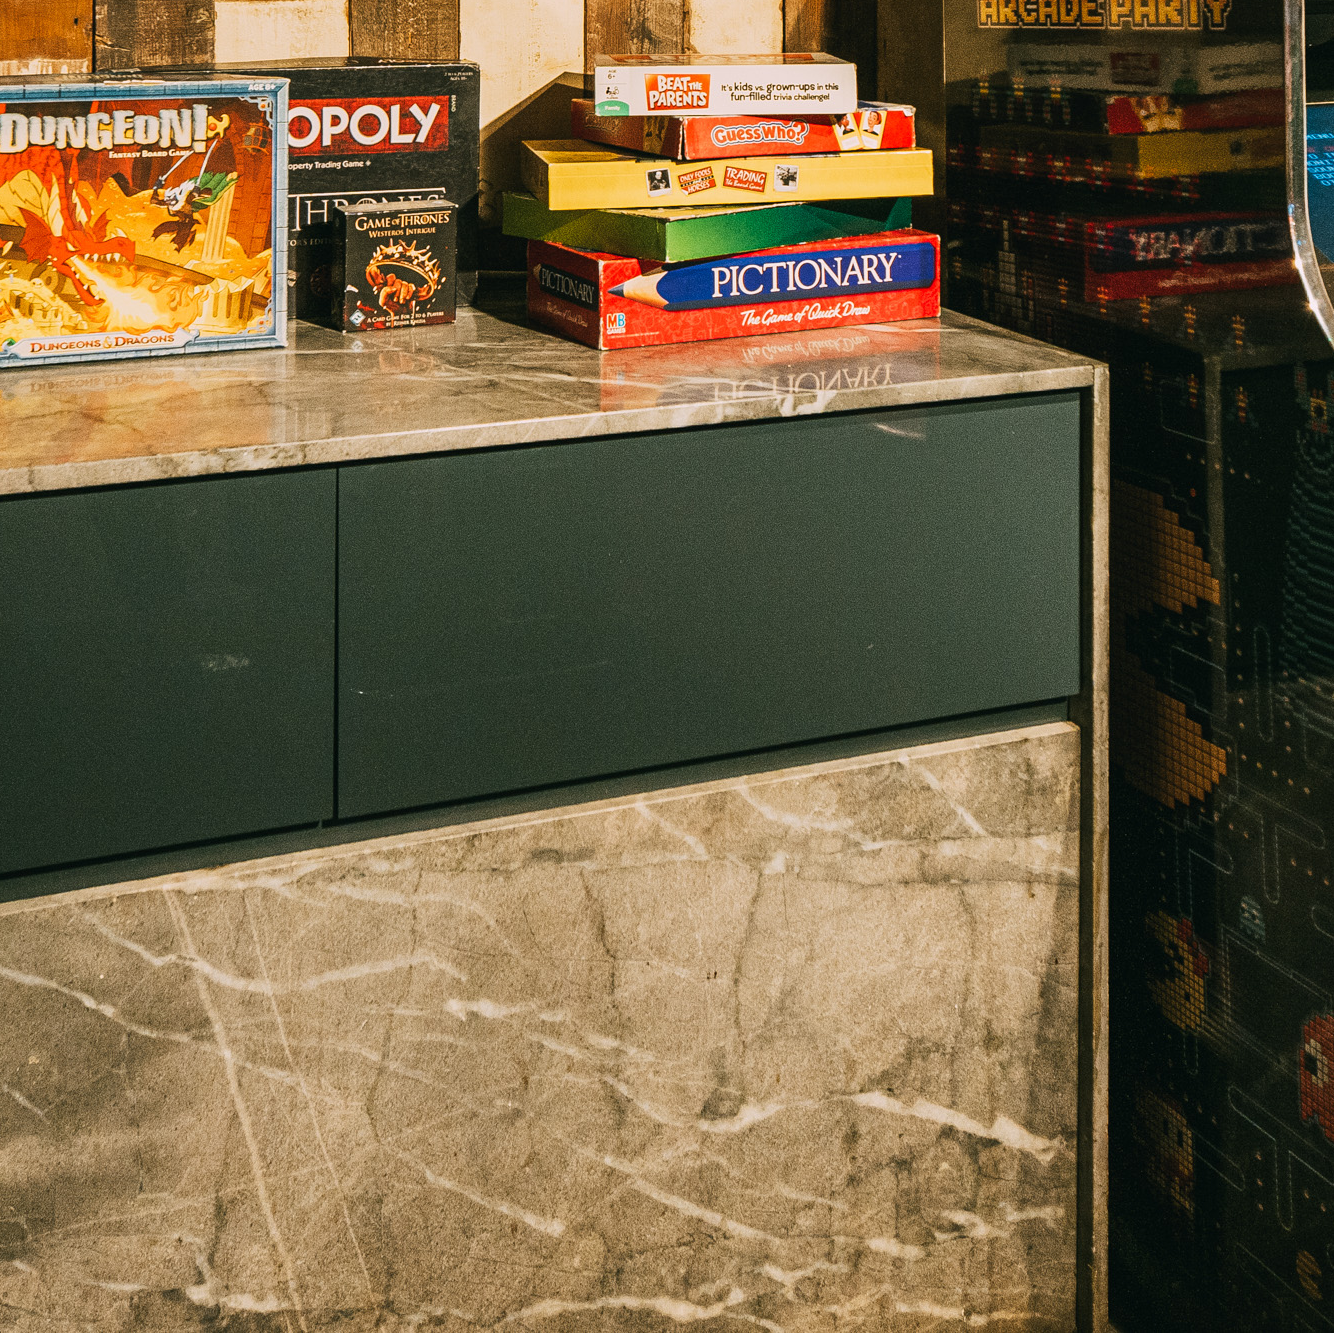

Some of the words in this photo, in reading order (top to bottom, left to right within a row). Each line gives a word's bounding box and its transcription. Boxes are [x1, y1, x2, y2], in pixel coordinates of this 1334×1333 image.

[657, 74, 688, 92] BEAT
[688, 81, 703, 91] THE
[721, 83, 733, 91] It's
[734, 82, 753, 91] kids
[766, 83, 816, 93] grown-ups
[825, 83, 839, 91] this
[649, 90, 707, 109] PARENTS
[730, 92, 772, 101] fun-filled
[774, 93, 792, 101] trivia
[793, 92, 830, 102] challenge!
[288, 102, 441, 148] OPOLY
[109, 150, 141, 159] FANTASY
[142, 149, 168, 158] BOARD
[314, 160, 342, 171] Trading
[343, 159, 364, 169] Game
[679, 172, 693, 184] ONLY
[694, 167, 711, 179] FOOLS
[726, 167, 765, 185] TRADING
[687, 181, 711, 195] HORSES
[355, 216, 391, 231] GAME
[398, 210, 452, 228] THRONES
[369, 229, 404, 238] WESTEROS
[405, 227, 436, 236] INTRIGUE
[712, 252, 897, 298] PICTIONARY
[540, 266, 595, 305] PICTIONARY
[607, 313, 626, 328] MB
[740, 310, 760, 327] The
[761, 307, 794, 326] Game
[794, 303, 806, 322] of
[807, 302, 841, 321] Quick
[842, 300, 871, 317] Draw
[30, 339, 101, 353] DUNGEONS
[114, 335, 175, 347] DRAGONS
